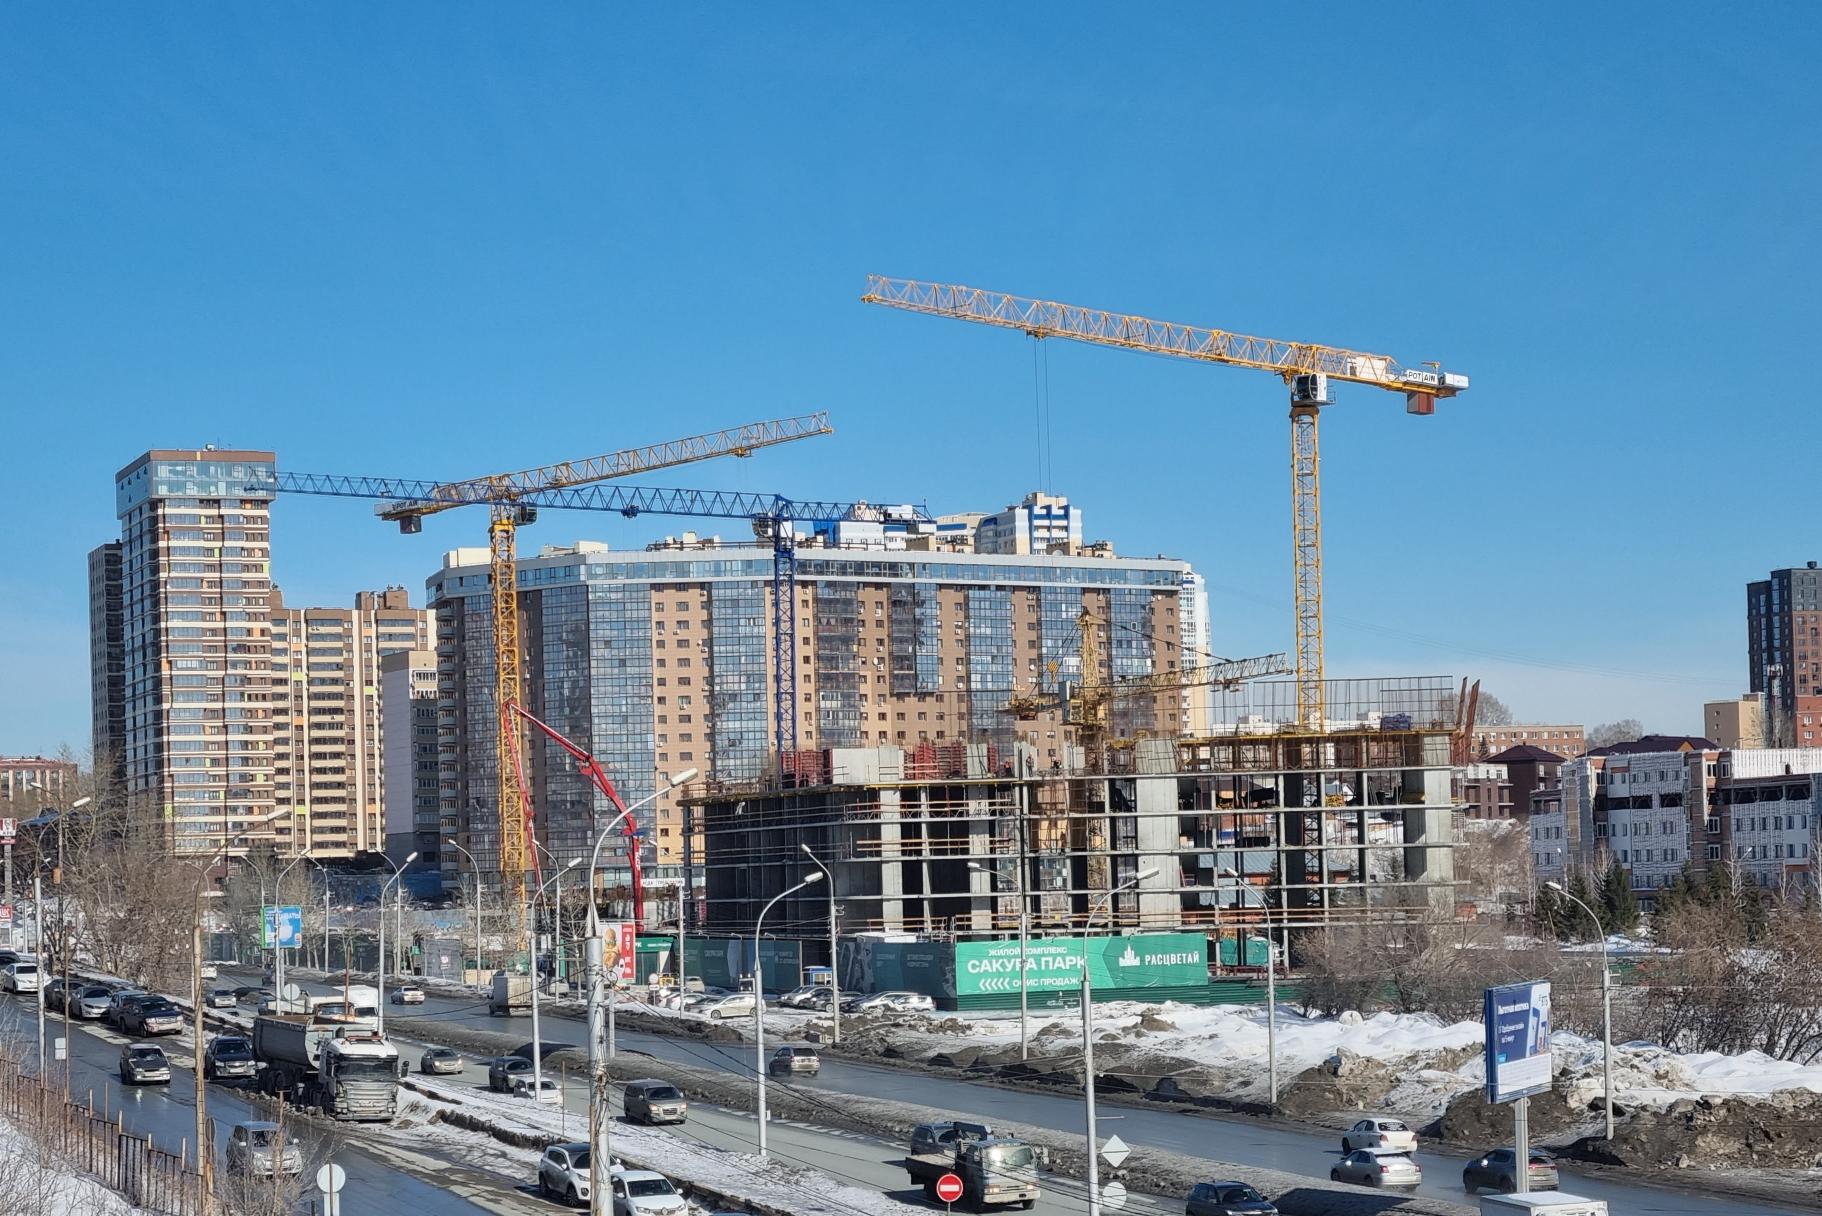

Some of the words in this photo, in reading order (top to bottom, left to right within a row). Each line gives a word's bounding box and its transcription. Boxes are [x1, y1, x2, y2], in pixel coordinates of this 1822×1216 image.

[989, 947, 1021, 956] ЖИЛОЙ
[1145, 950, 1200, 966] РАСЦВЕТАЙ
[967, 957, 1038, 974] САКУРА
[1041, 955, 1088, 971] ПАРК
[1040, 976, 1081, 986] ПРОДАЖ
